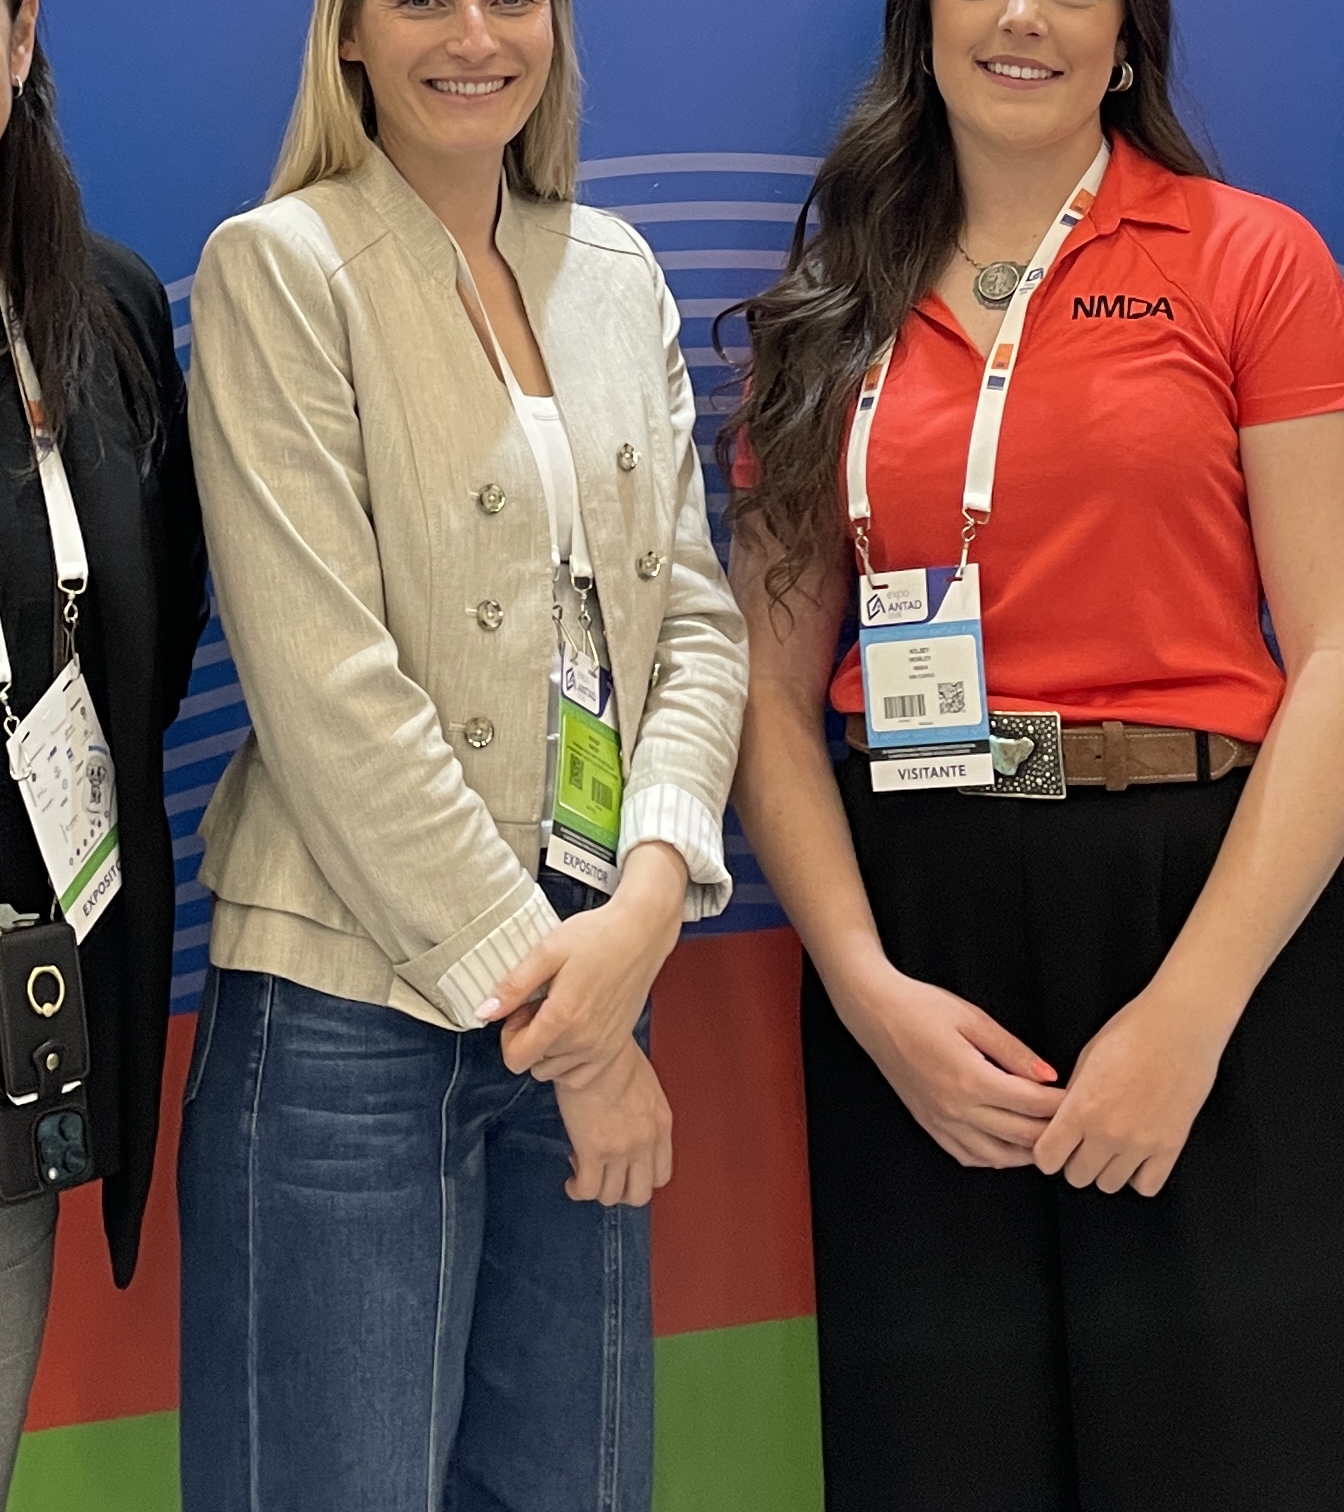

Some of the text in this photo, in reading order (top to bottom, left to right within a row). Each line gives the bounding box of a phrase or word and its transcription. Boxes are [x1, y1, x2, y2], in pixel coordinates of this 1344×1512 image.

[1071, 294, 1174, 321] NMDA
[888, 599, 923, 611] ANTAD
[898, 764, 967, 781] VISITANTE
